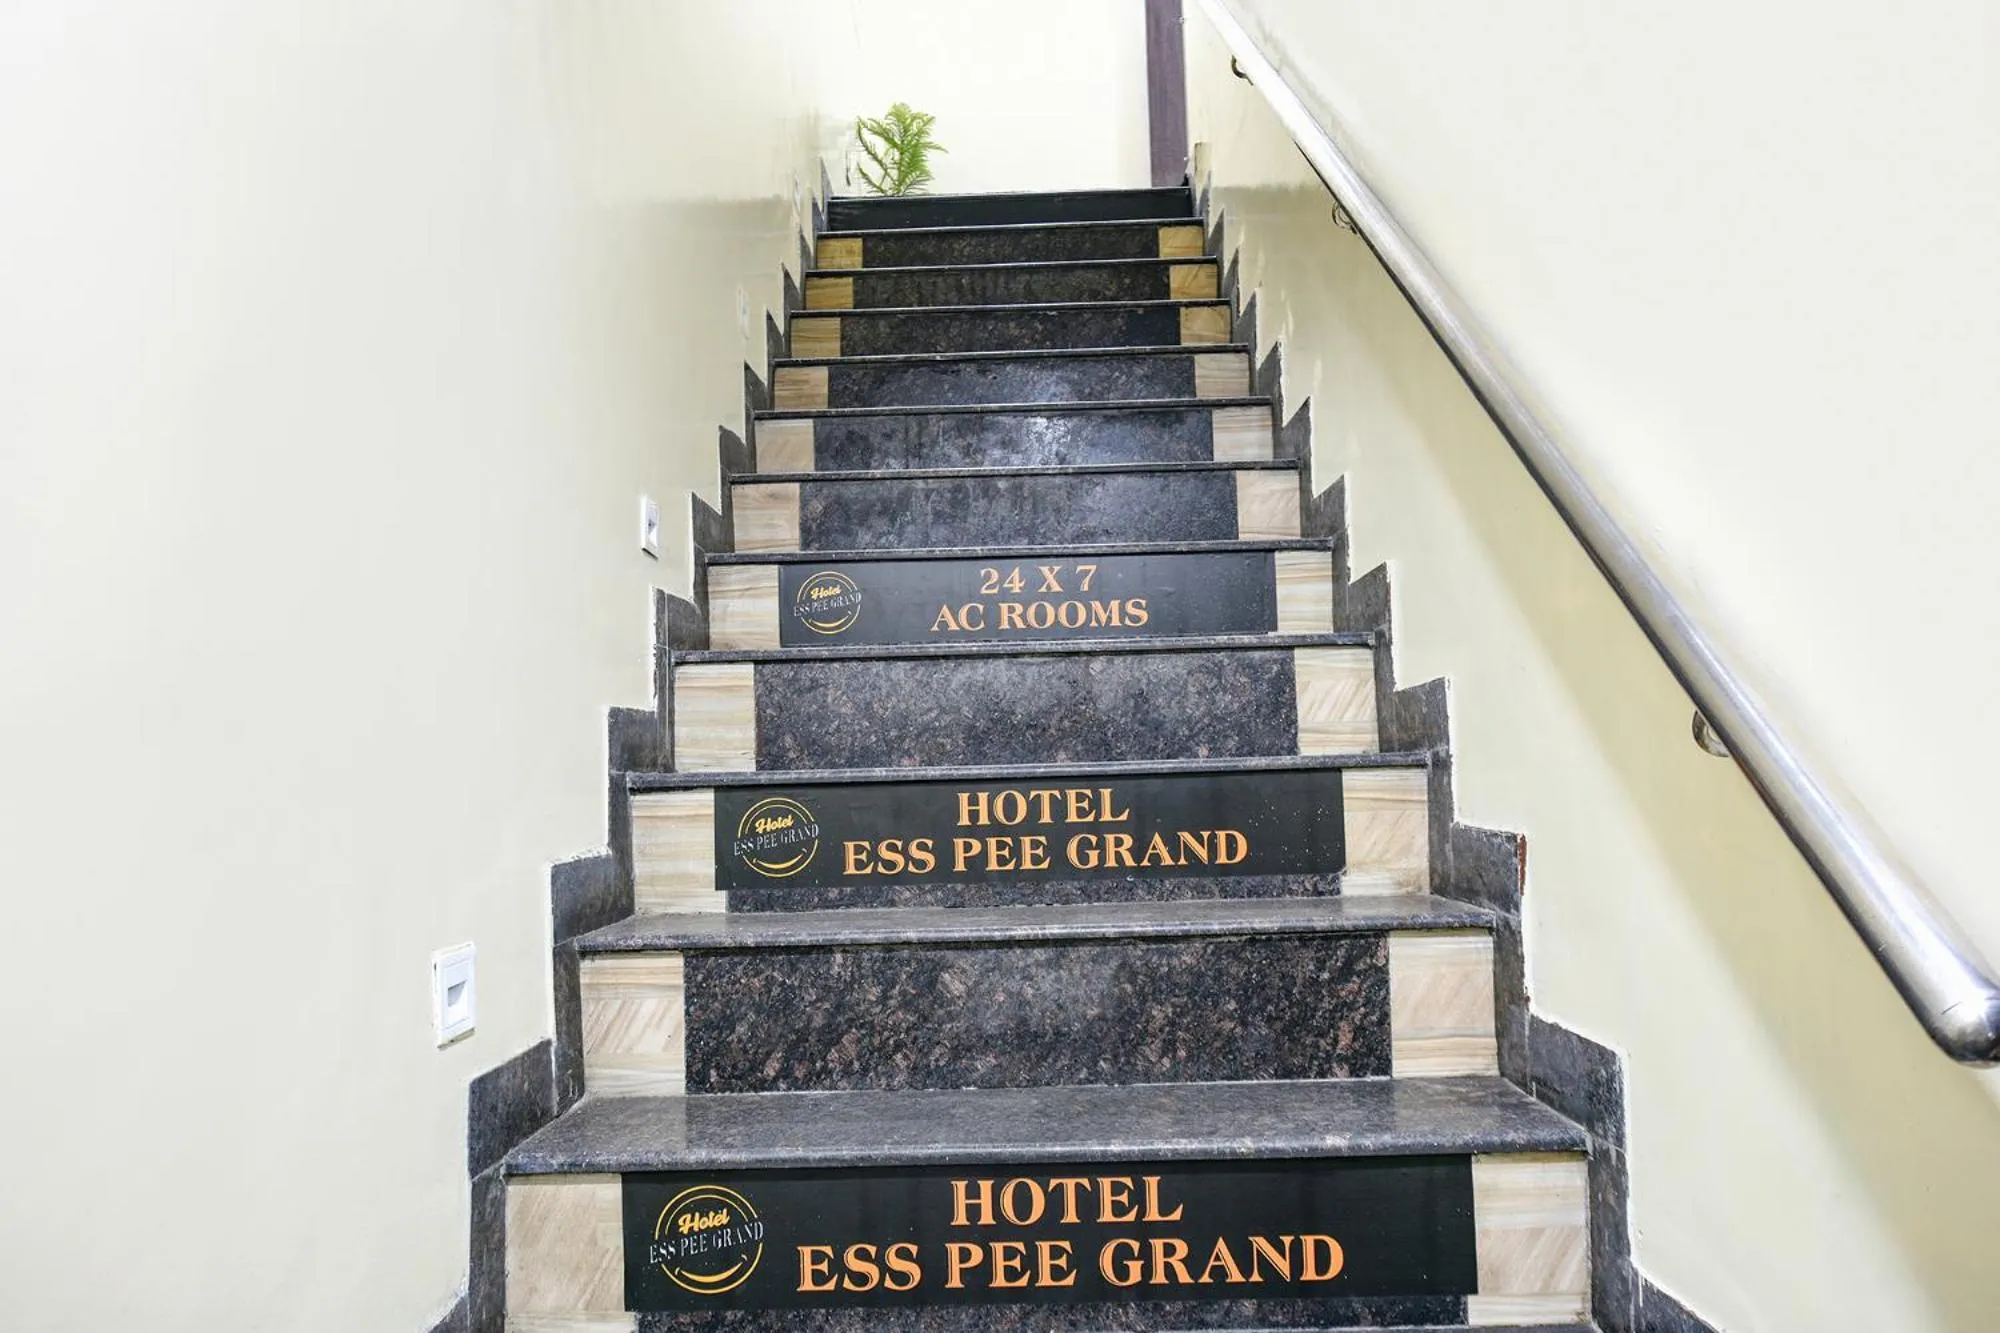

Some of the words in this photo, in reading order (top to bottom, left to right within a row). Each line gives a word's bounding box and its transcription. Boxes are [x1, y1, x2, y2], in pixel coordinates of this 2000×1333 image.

[980, 567, 1025, 594] 24
[1038, 566, 1068, 593] X
[1075, 565, 1098, 592] 7
[931, 603, 985, 632] AC
[998, 599, 1149, 630] ROOMS
[755, 814, 794, 834] Hotel
[957, 788, 1129, 827] HOTEL
[843, 839, 936, 876] ESS
[953, 835, 1050, 873] PEE
[1066, 829, 1248, 868] GRAND
[951, 1175, 1183, 1227] HOTEL
[678, 1208, 730, 1235] Hotel
[649, 1239, 677, 1264] ESS
[680, 1233, 708, 1257] PEE
[711, 1220, 764, 1250] GRAND
[797, 1243, 922, 1293] ESS
[944, 1239, 1076, 1290] PEE
[1100, 1234, 1345, 1287] GRAND
